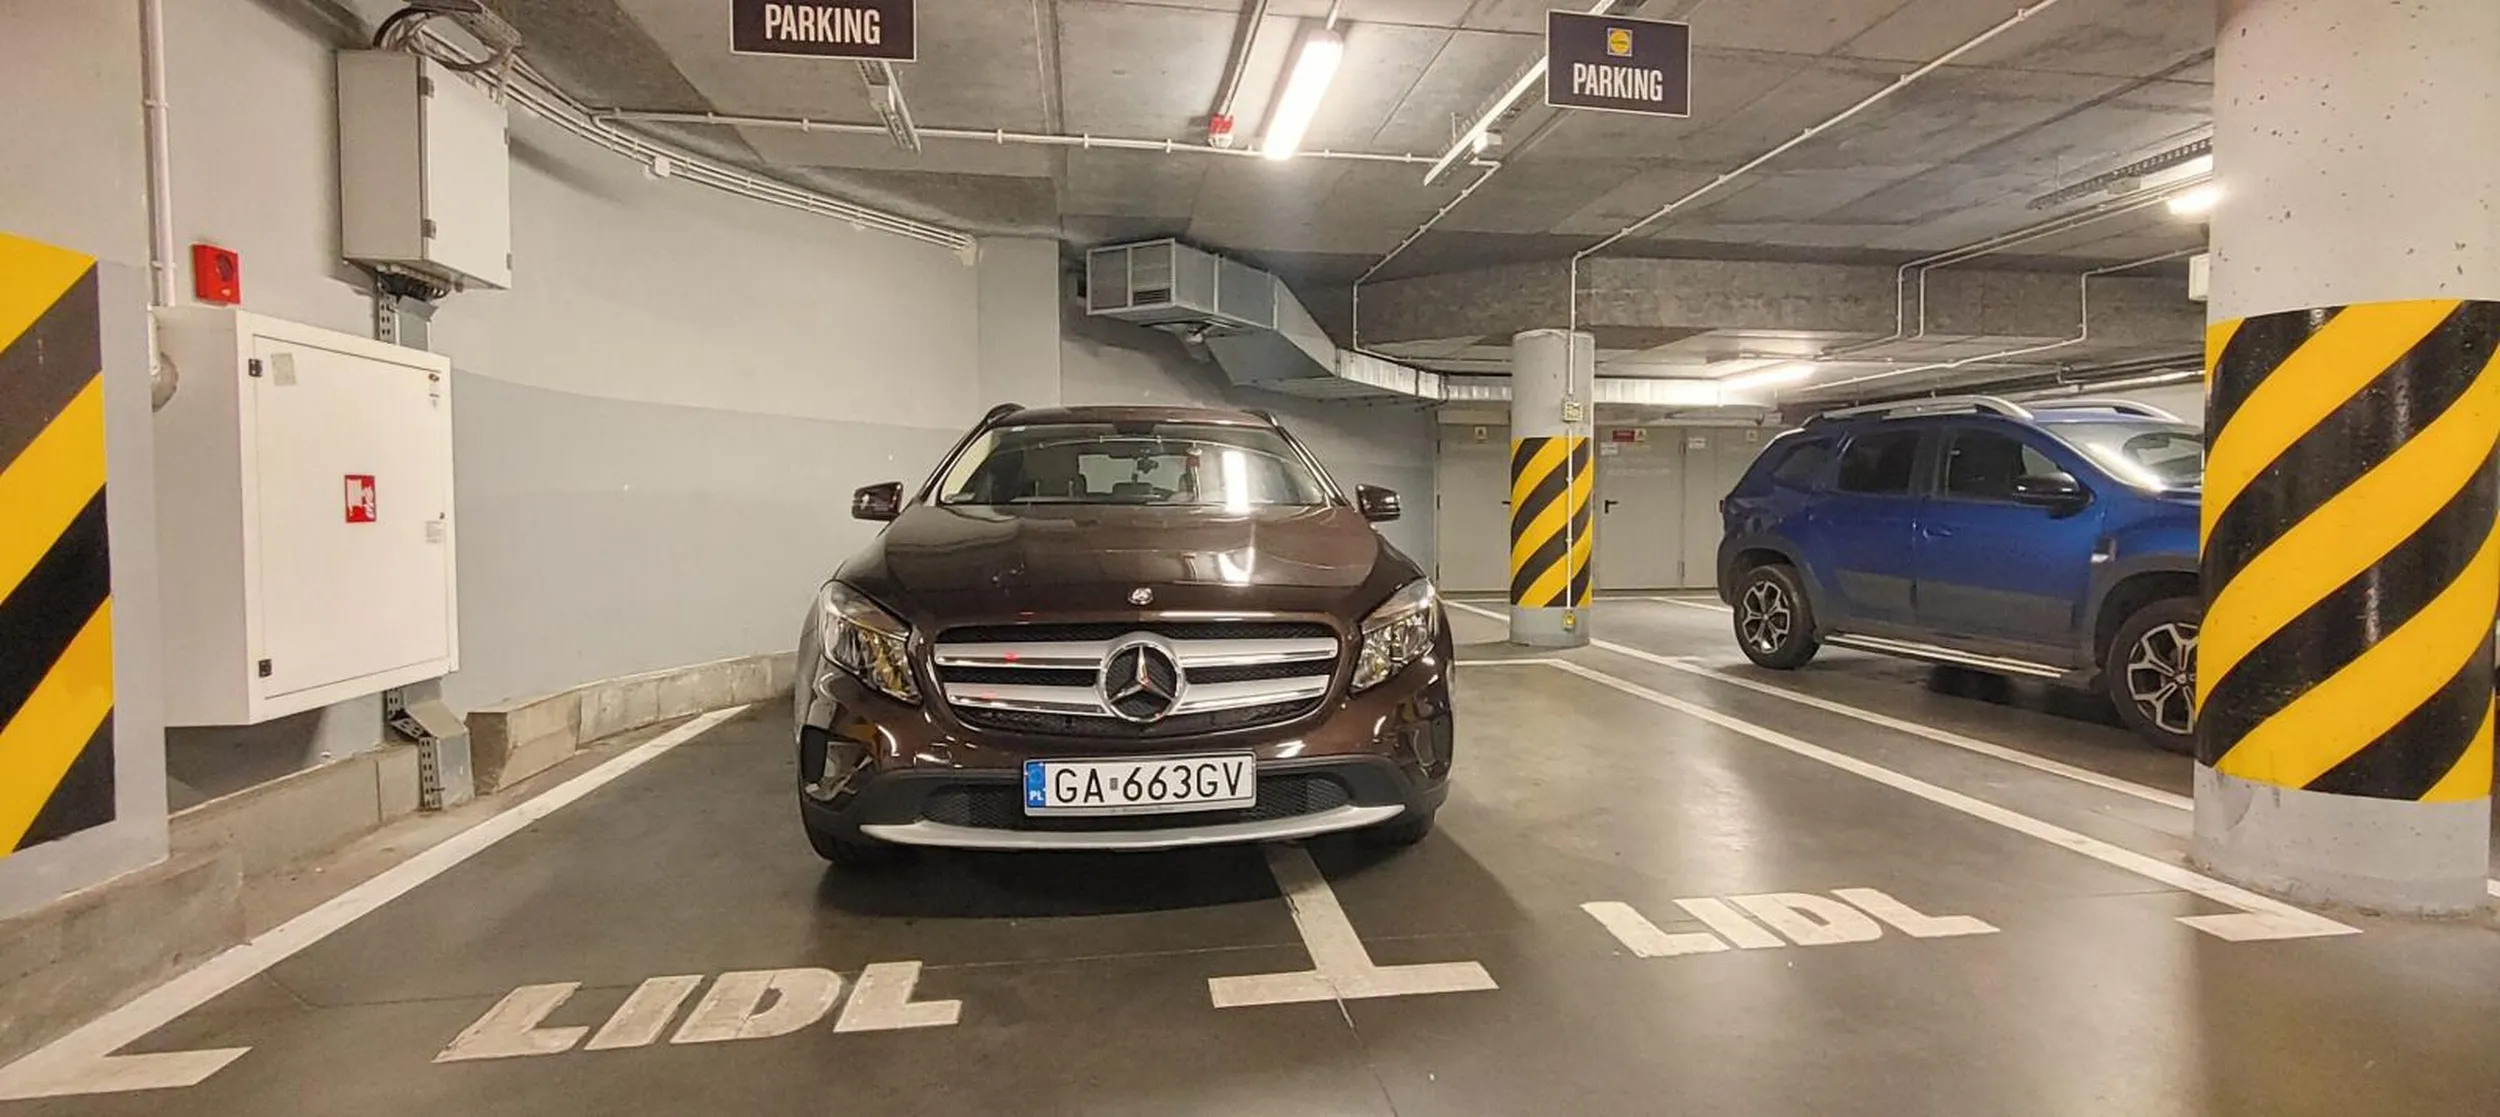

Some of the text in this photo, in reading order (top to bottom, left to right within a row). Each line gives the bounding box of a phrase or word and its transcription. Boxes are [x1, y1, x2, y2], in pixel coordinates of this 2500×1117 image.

[764, 3, 881, 45] PARKING
[1572, 62, 1663, 101] PARKING
[1029, 790, 1044, 801] PL
[1055, 761, 1243, 804] GA 663GV
[1579, 888, 2001, 958] LIDL
[431, 961, 963, 1063] LIDL
